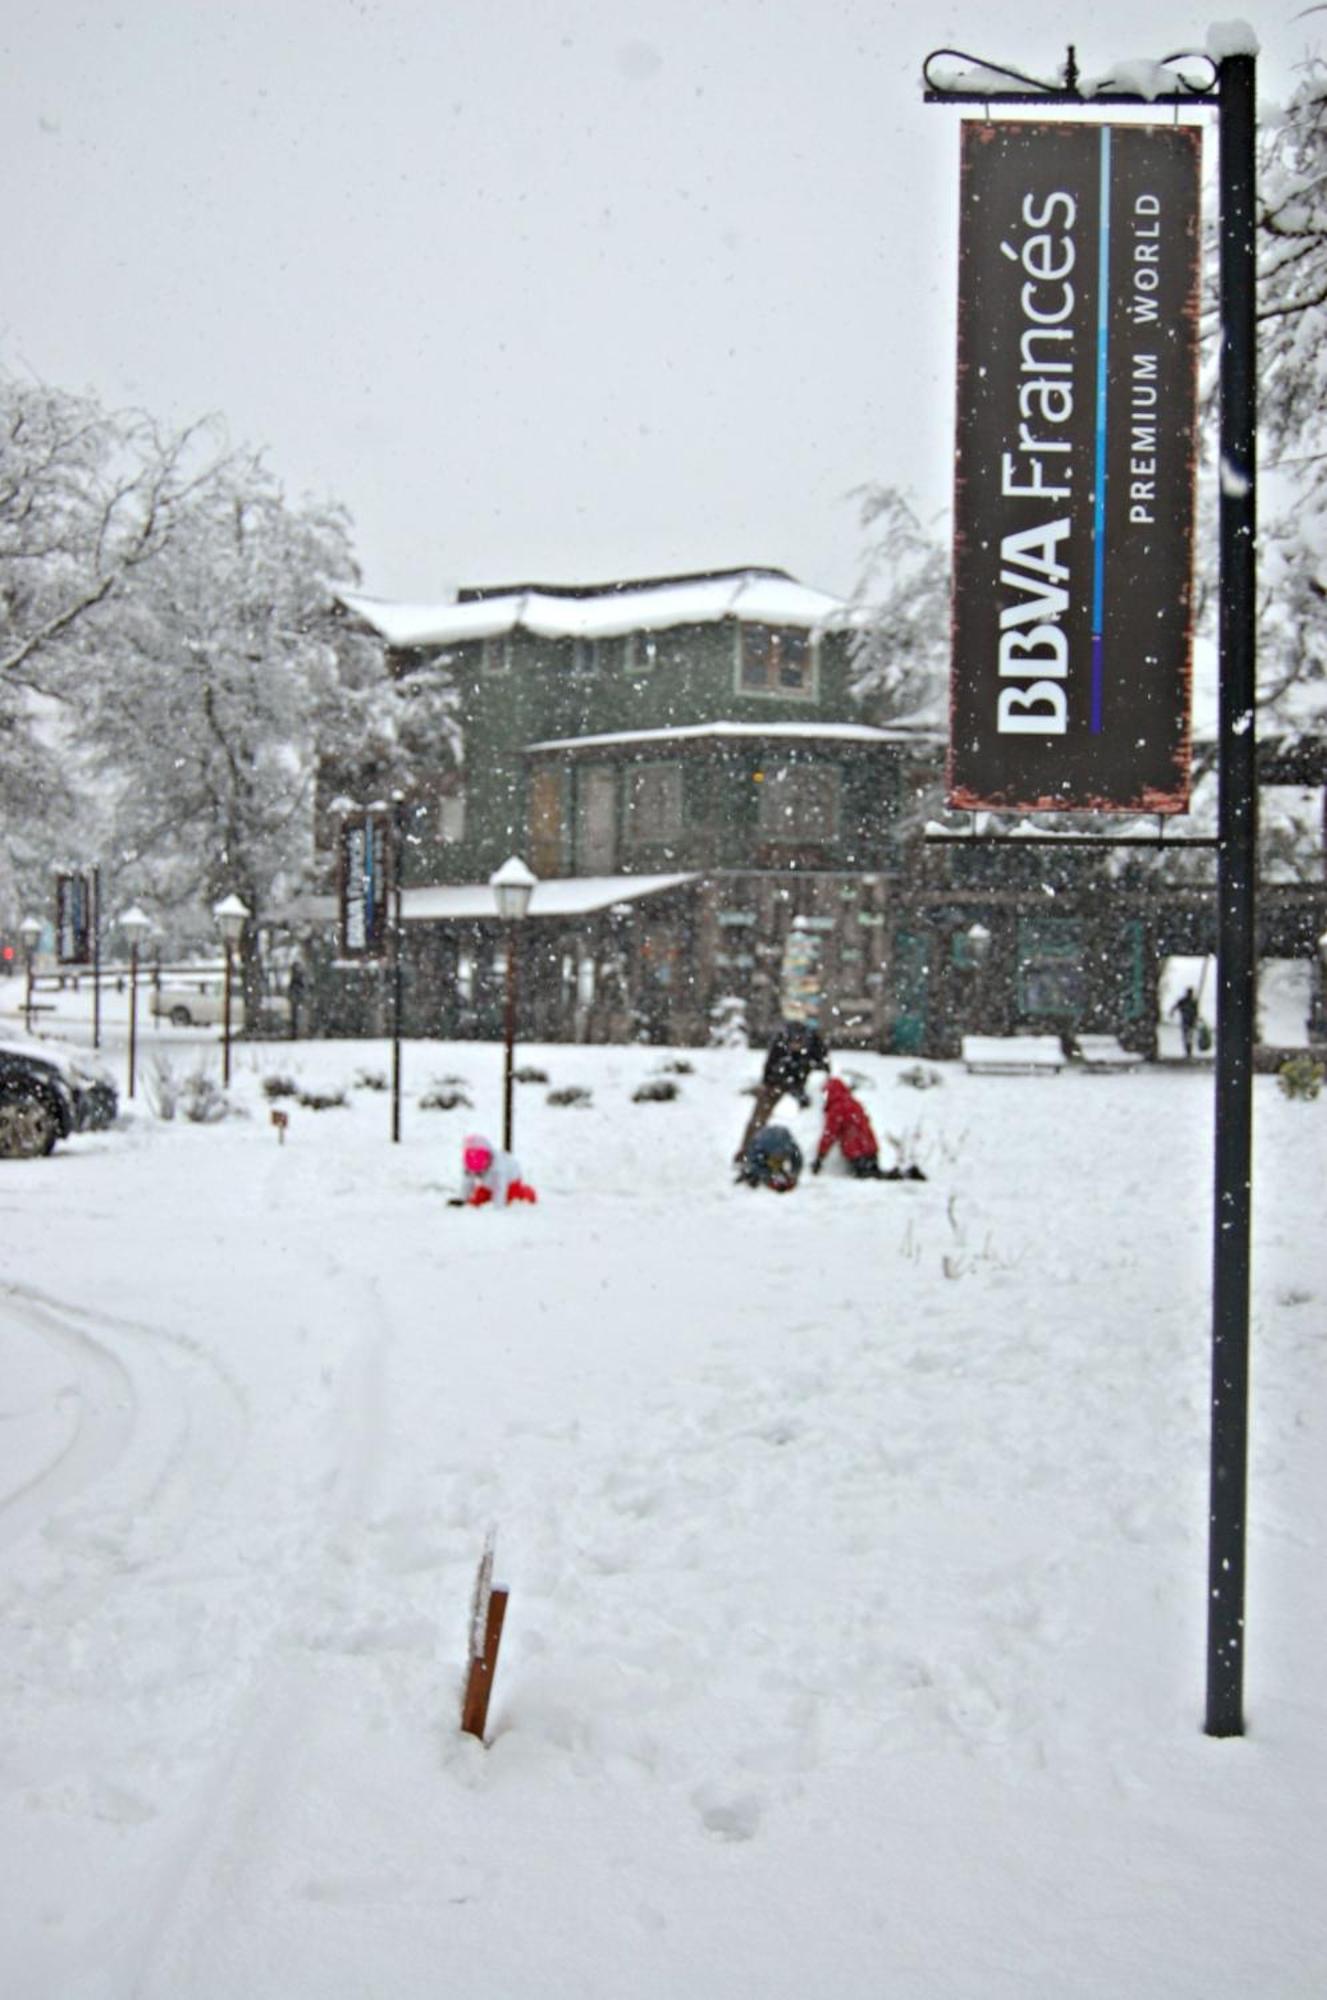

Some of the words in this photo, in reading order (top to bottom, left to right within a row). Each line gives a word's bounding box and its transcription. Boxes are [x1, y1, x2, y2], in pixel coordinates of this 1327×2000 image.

[1000, 191, 1077, 501] Francés
[1132, 194, 1160, 323] WORLD
[1129, 354, 1158, 525] PREMIUM
[997, 517, 1071, 735] BBVA
